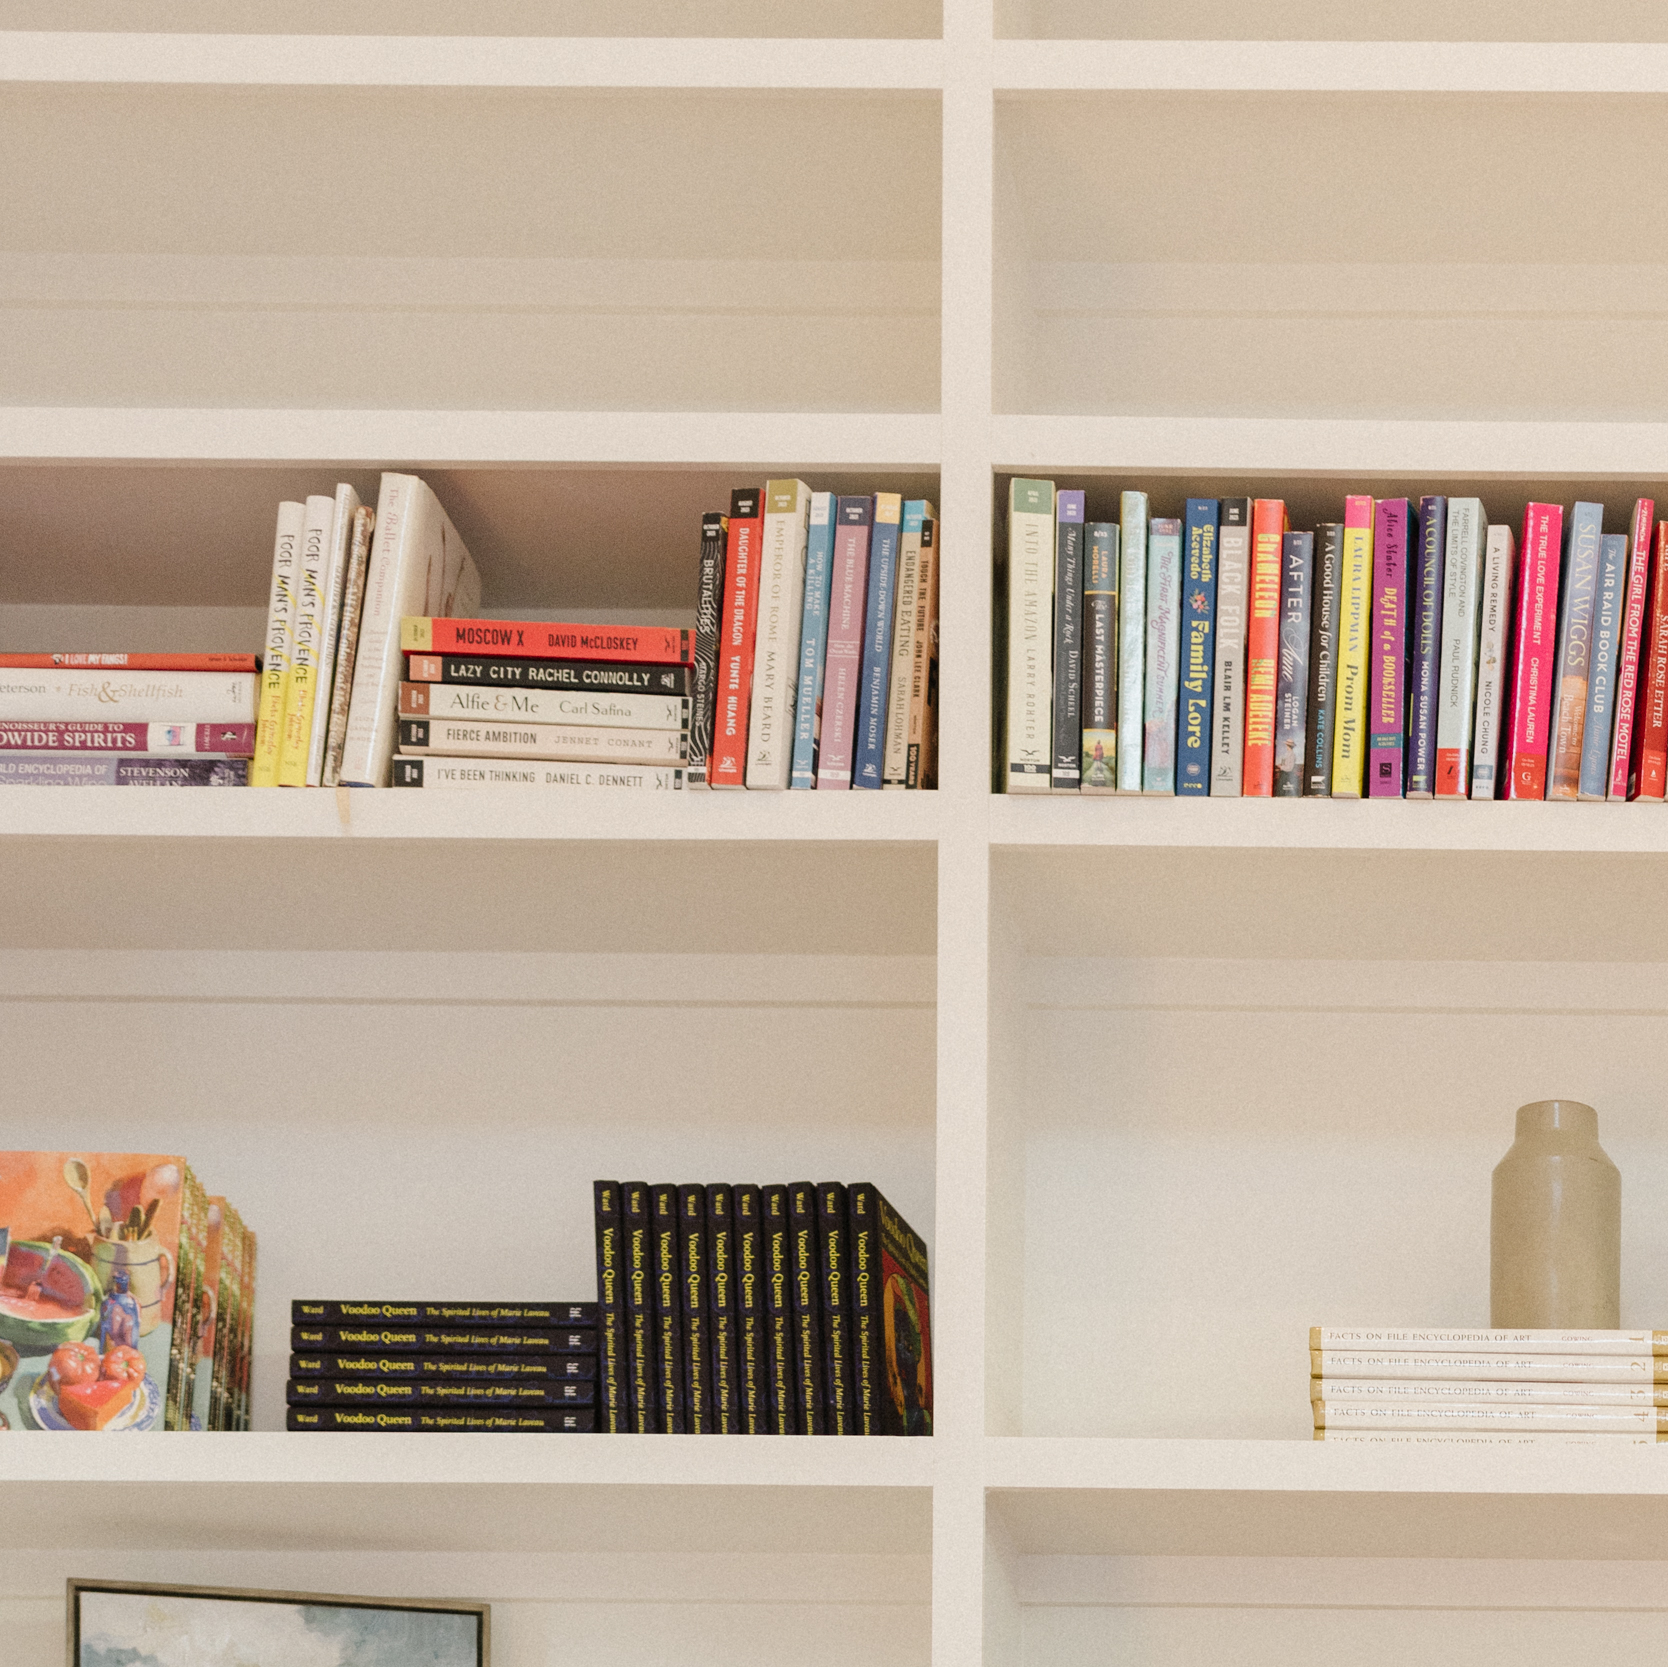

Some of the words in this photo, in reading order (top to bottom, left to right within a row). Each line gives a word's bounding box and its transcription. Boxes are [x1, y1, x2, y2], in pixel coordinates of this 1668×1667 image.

[736, 527, 750, 574] DAUGHTER
[1221, 536, 1243, 599] BLACK
[1574, 523, 1595, 588] SUSAN
[735, 589, 745, 608] THE
[737, 577, 745, 587] OF
[1288, 555, 1303, 623] AFTER
[456, 627, 512, 646] MOSCOW
[517, 630, 524, 646] X
[732, 609, 744, 646] DRAGON
[1218, 608, 1239, 650] FOLK
[1568, 596, 1590, 666] WIGGS
[450, 664, 483, 677] LAZY
[490, 667, 521, 679] CITY
[729, 656, 741, 689] YUNTE
[1184, 620, 1209, 692] Family
[726, 696, 738, 736] HUANG
[1187, 699, 1207, 749] Lore
[63, 733, 136, 748] SPIRITS
[302, 1306, 324, 1314] Ward
[340, 1304, 380, 1315] Voodoo
[382, 1306, 417, 1316] Queen
[1330, 1332, 1361, 1341] FACTS
[1366, 1333, 1382, 1341] ON
[1387, 1333, 1409, 1342] FILE
[1413, 1333, 1492, 1343] ENCYCLOPEDIA
[1495, 1334, 1509, 1342] OF
[1512, 1334, 1532, 1342] ART
